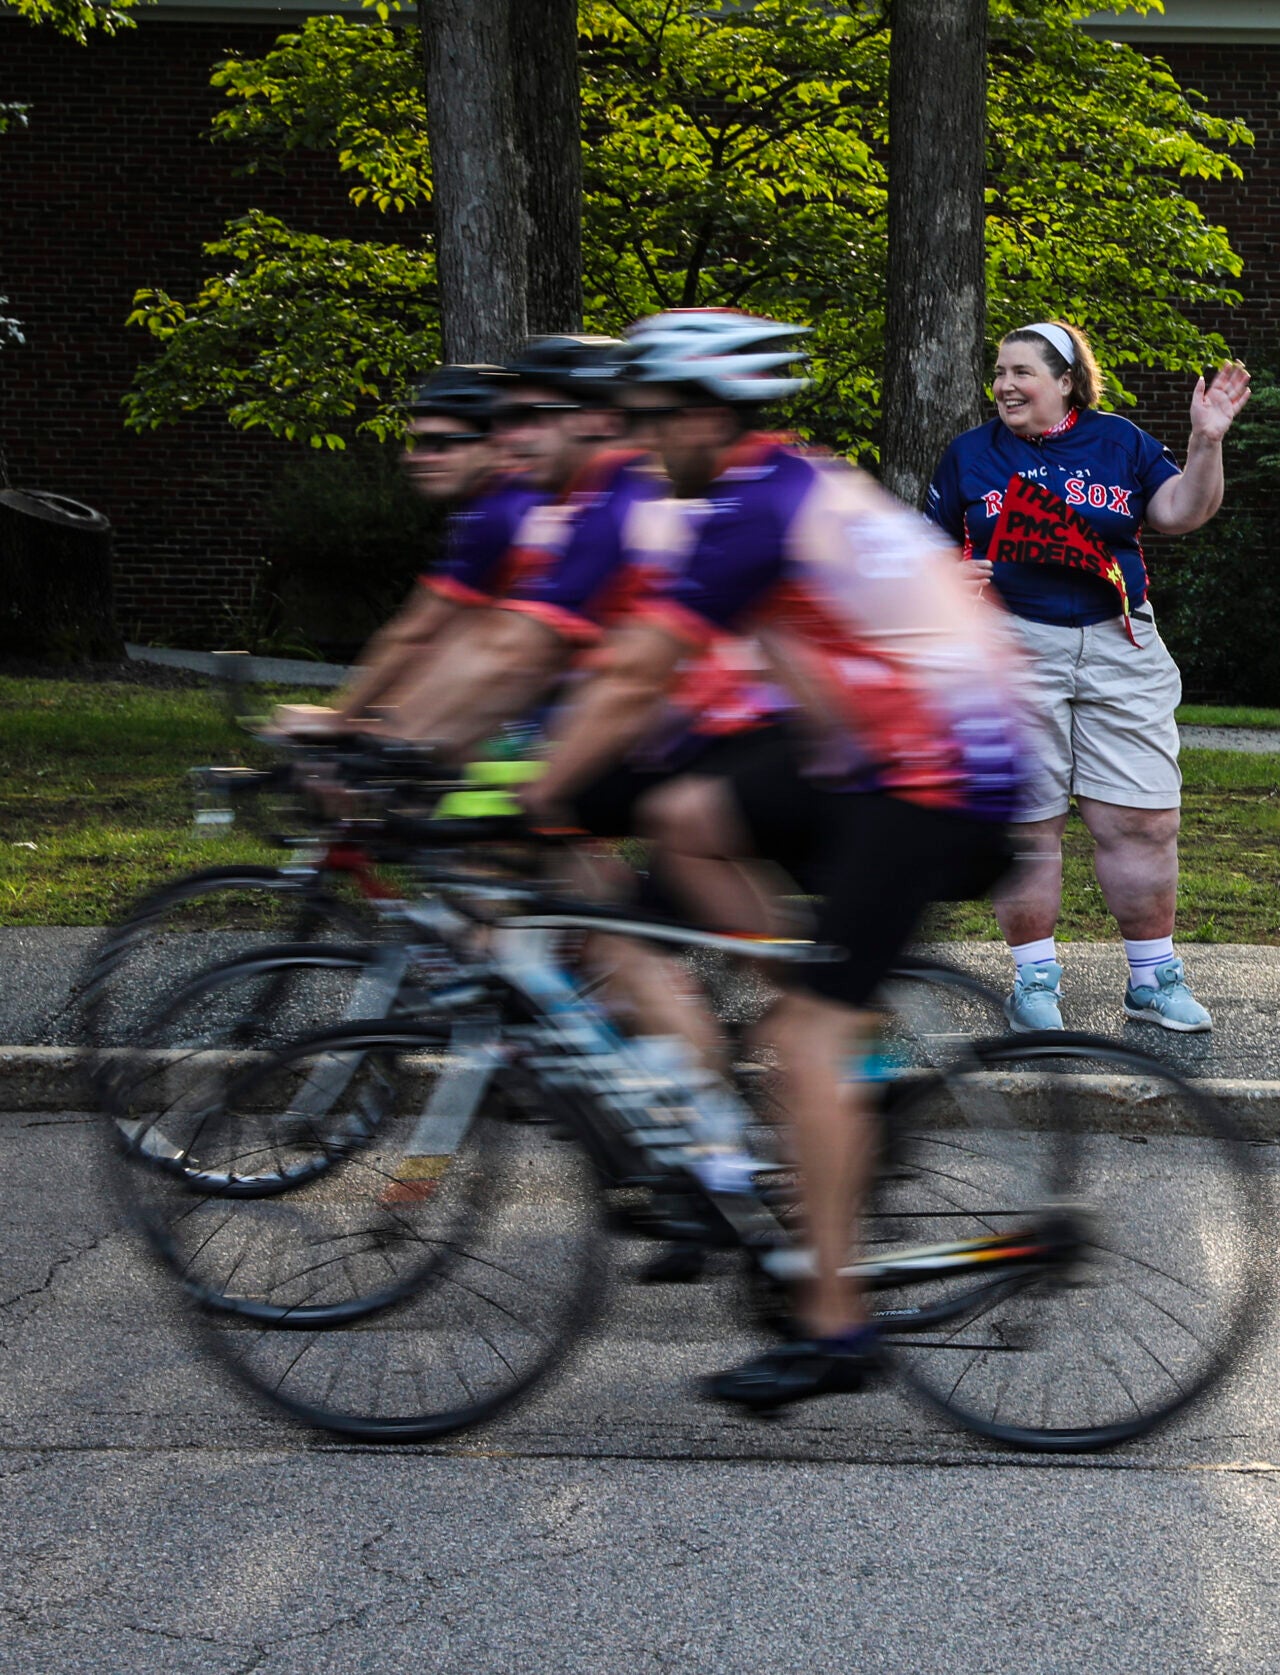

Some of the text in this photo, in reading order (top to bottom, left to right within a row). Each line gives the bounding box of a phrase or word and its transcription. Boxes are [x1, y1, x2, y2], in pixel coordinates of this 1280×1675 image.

[1065, 477, 1133, 517] SOX
[1005, 511, 1069, 542] PMC
[996, 540, 1101, 574] RIDERS
